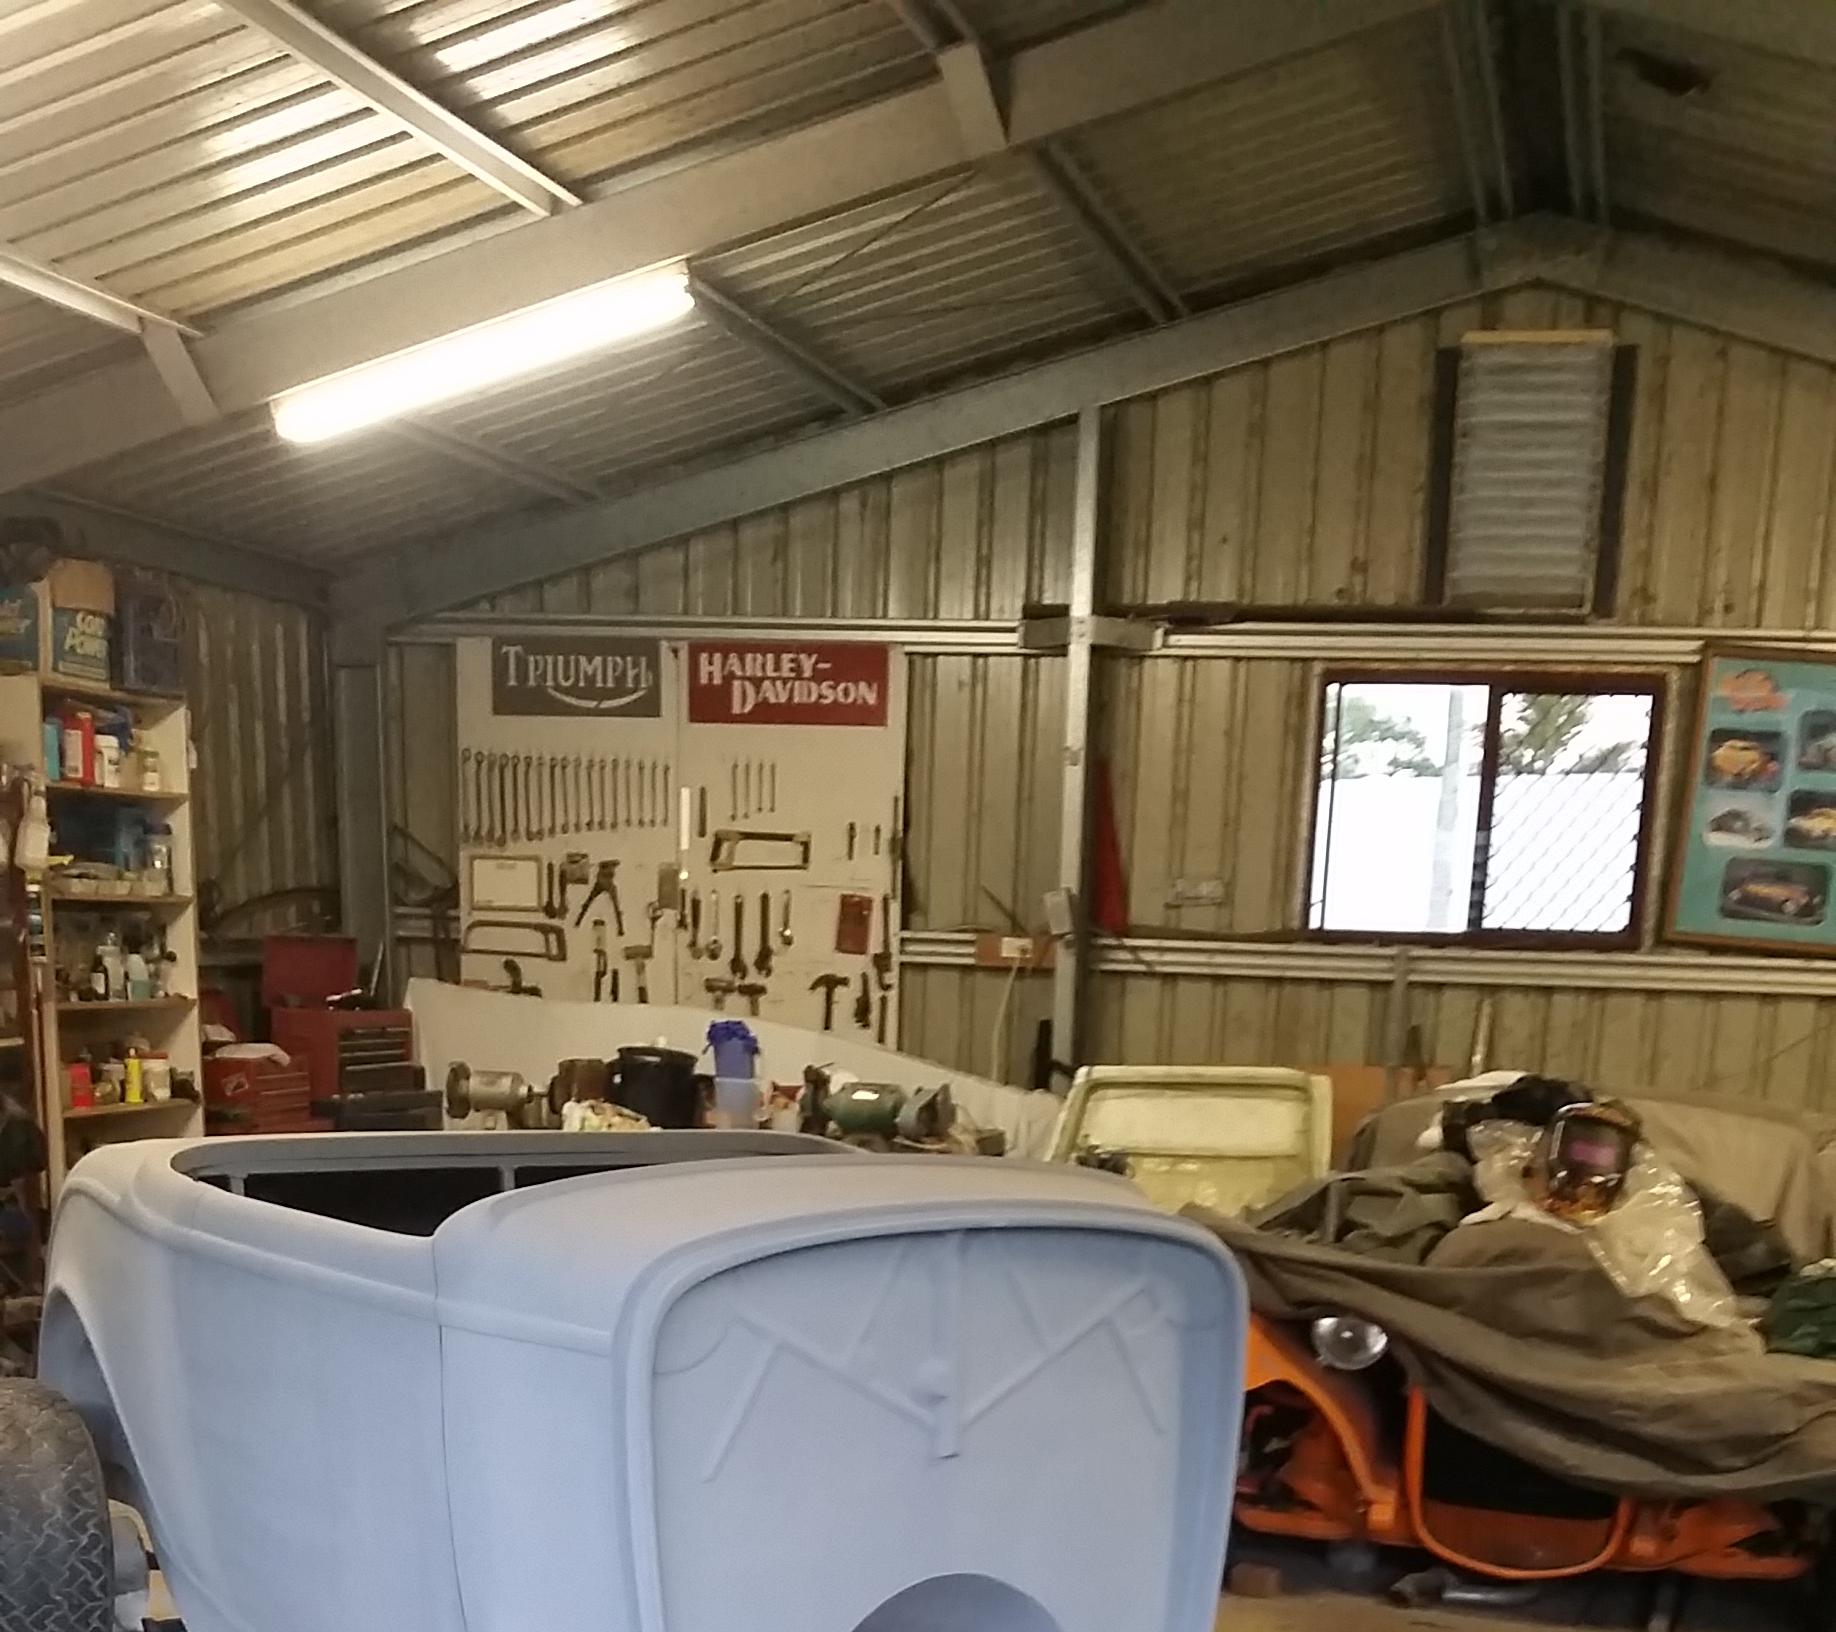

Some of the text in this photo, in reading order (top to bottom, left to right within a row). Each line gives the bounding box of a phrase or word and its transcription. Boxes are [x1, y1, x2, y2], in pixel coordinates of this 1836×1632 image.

[502, 645, 653, 687] TRIUMPH
[700, 652, 832, 684] HARLEY-
[731, 680, 878, 714] DAVIDSON
